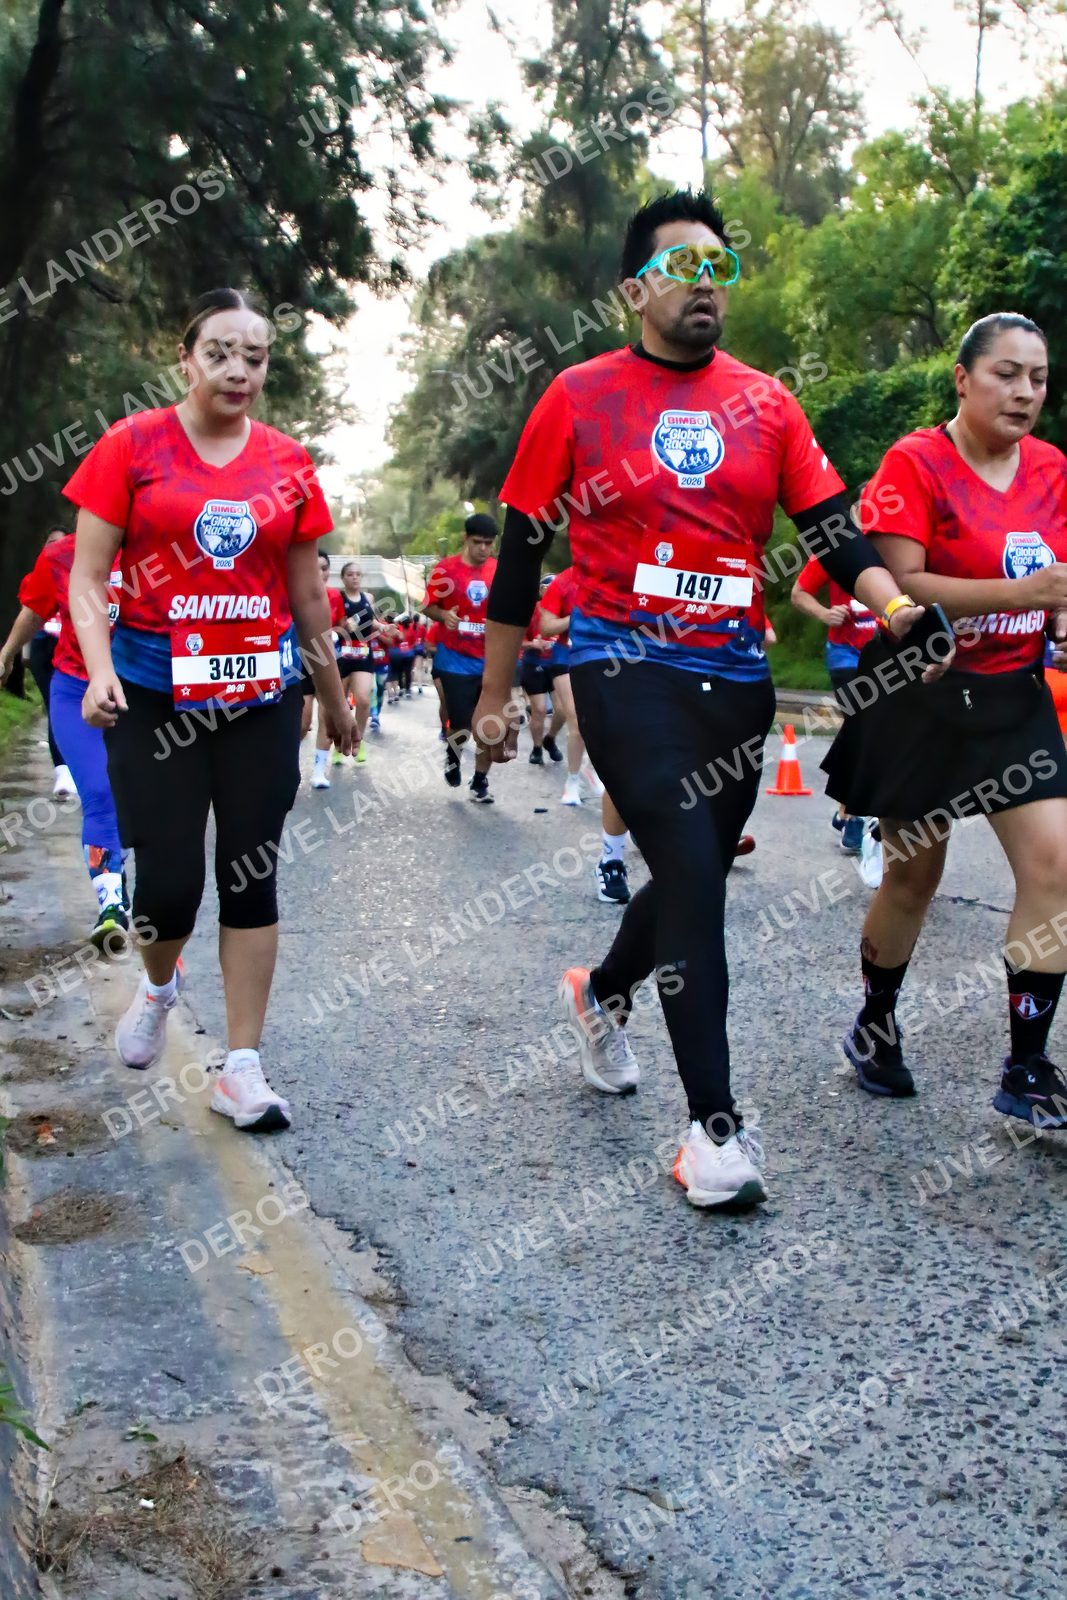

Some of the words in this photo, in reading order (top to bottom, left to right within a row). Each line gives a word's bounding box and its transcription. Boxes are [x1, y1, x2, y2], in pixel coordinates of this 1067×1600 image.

[667, 416, 705, 425] BIMBO
[669, 428, 706, 441] Global
[663, 437, 693, 450] Race
[680, 476, 703, 486] 2026
[210, 515, 244, 528] Global
[203, 525, 230, 536] Race
[1015, 546, 1041, 557] Global
[215, 559, 232, 568] 2026
[1011, 555, 1034, 567] Race
[675, 572, 723, 602] 1497
[168, 594, 271, 620] SANTIAGO
[727, 619, 740, 628] 5K
[209, 655, 257, 681] 3420
